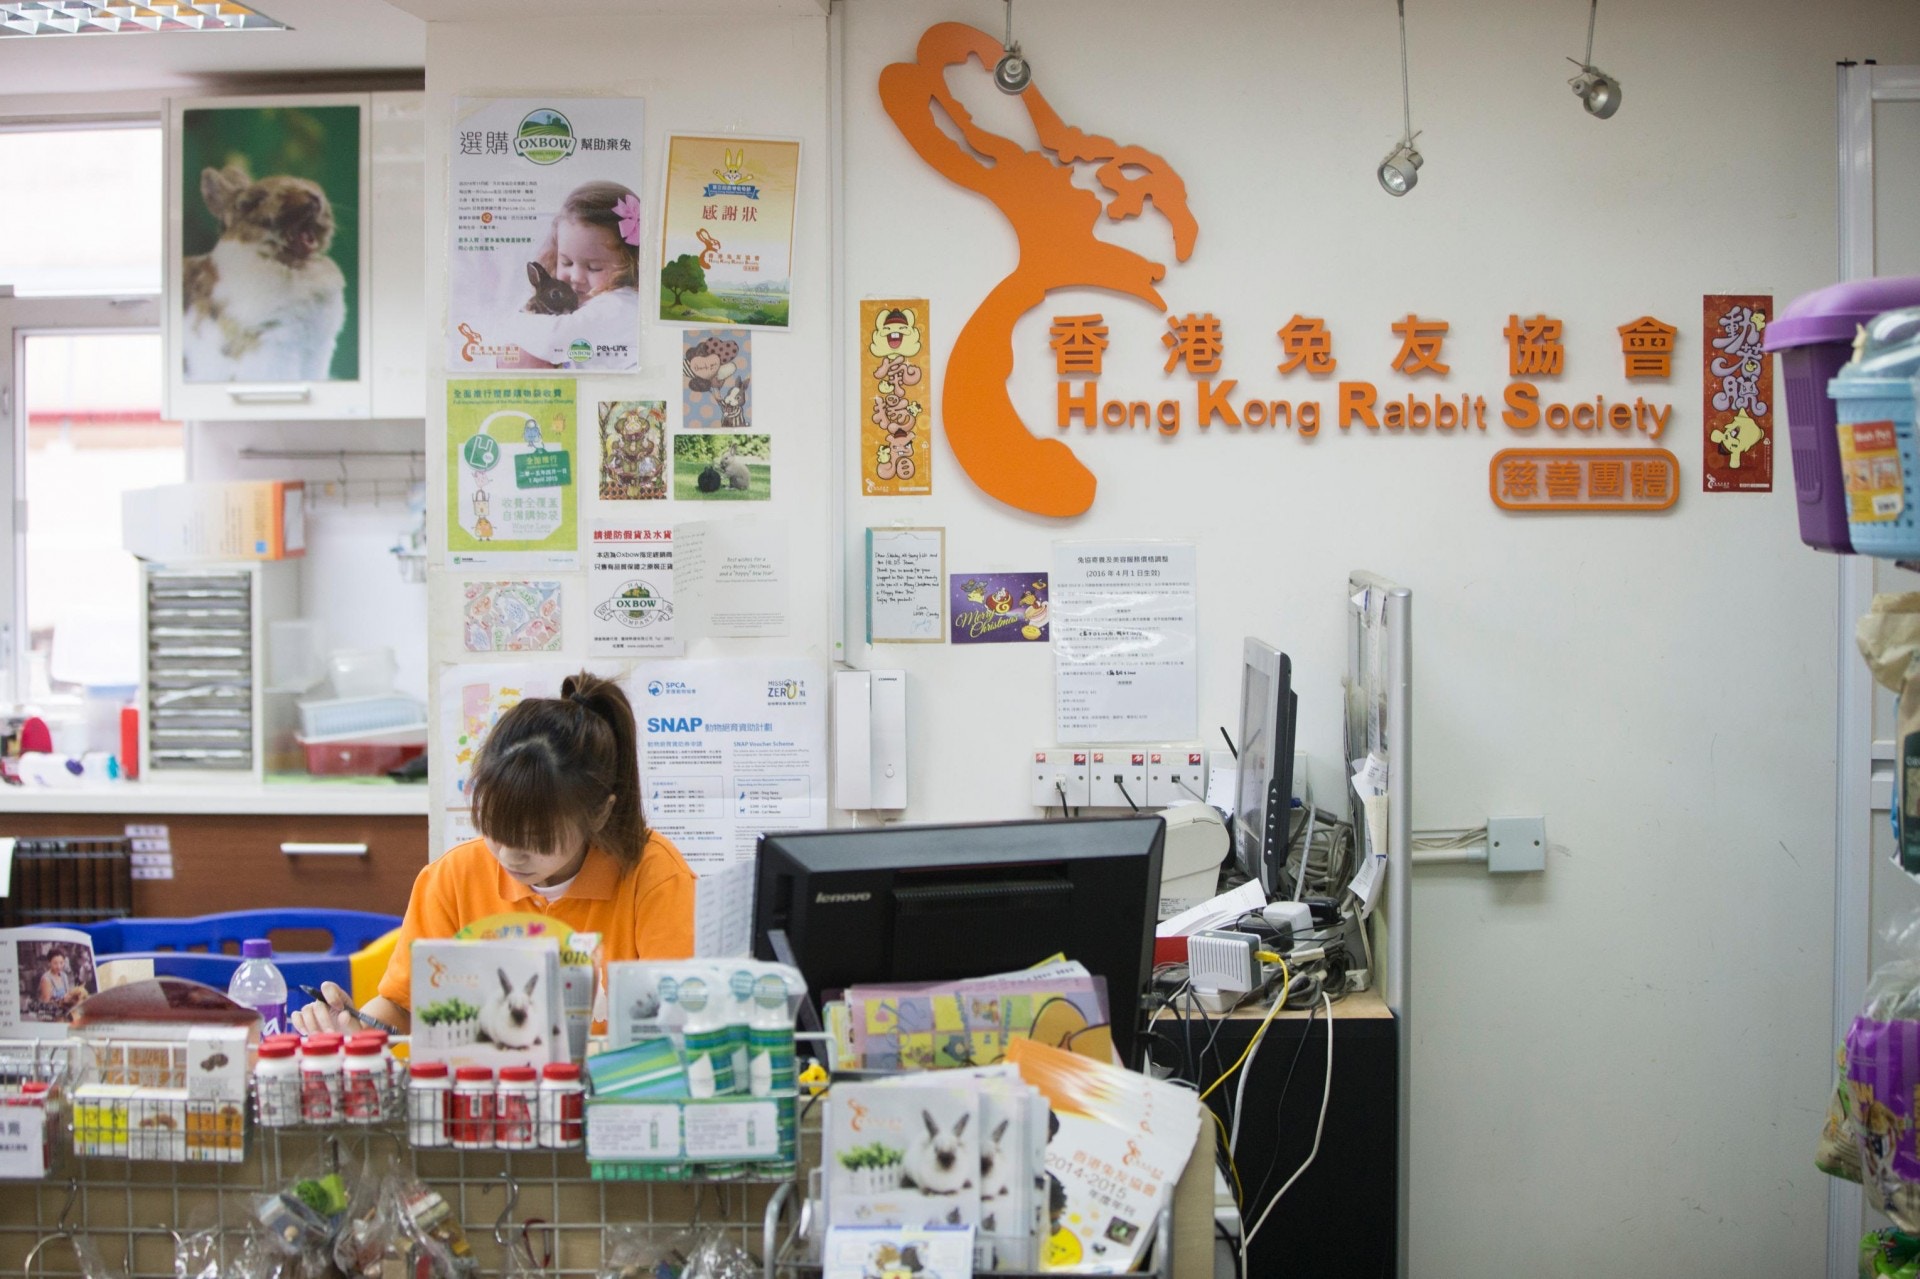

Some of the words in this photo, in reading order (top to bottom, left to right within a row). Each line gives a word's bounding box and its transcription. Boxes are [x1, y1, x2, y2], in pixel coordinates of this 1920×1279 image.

[460, 131, 508, 155] 選購
[518, 137, 572, 149] OXBOW
[581, 138, 631, 151] 幫助棄兔
[703, 204, 758, 222] 感謝狀
[1049, 313, 1677, 377] 香港兔友協會
[1057, 381, 1180, 436] Hong
[1197, 380, 1320, 436] Kong
[1339, 382, 1487, 430] Rabbit
[1502, 382, 1673, 439] Society
[1502, 461, 1668, 498] 慈善團體
[593, 530, 672, 540] 請提防假貨及水貨
[955, 608, 996, 628] Merry
[970, 615, 1018, 638] Christmas
[647, 717, 703, 733] SNAP
[815, 892, 871, 903] lenovo
